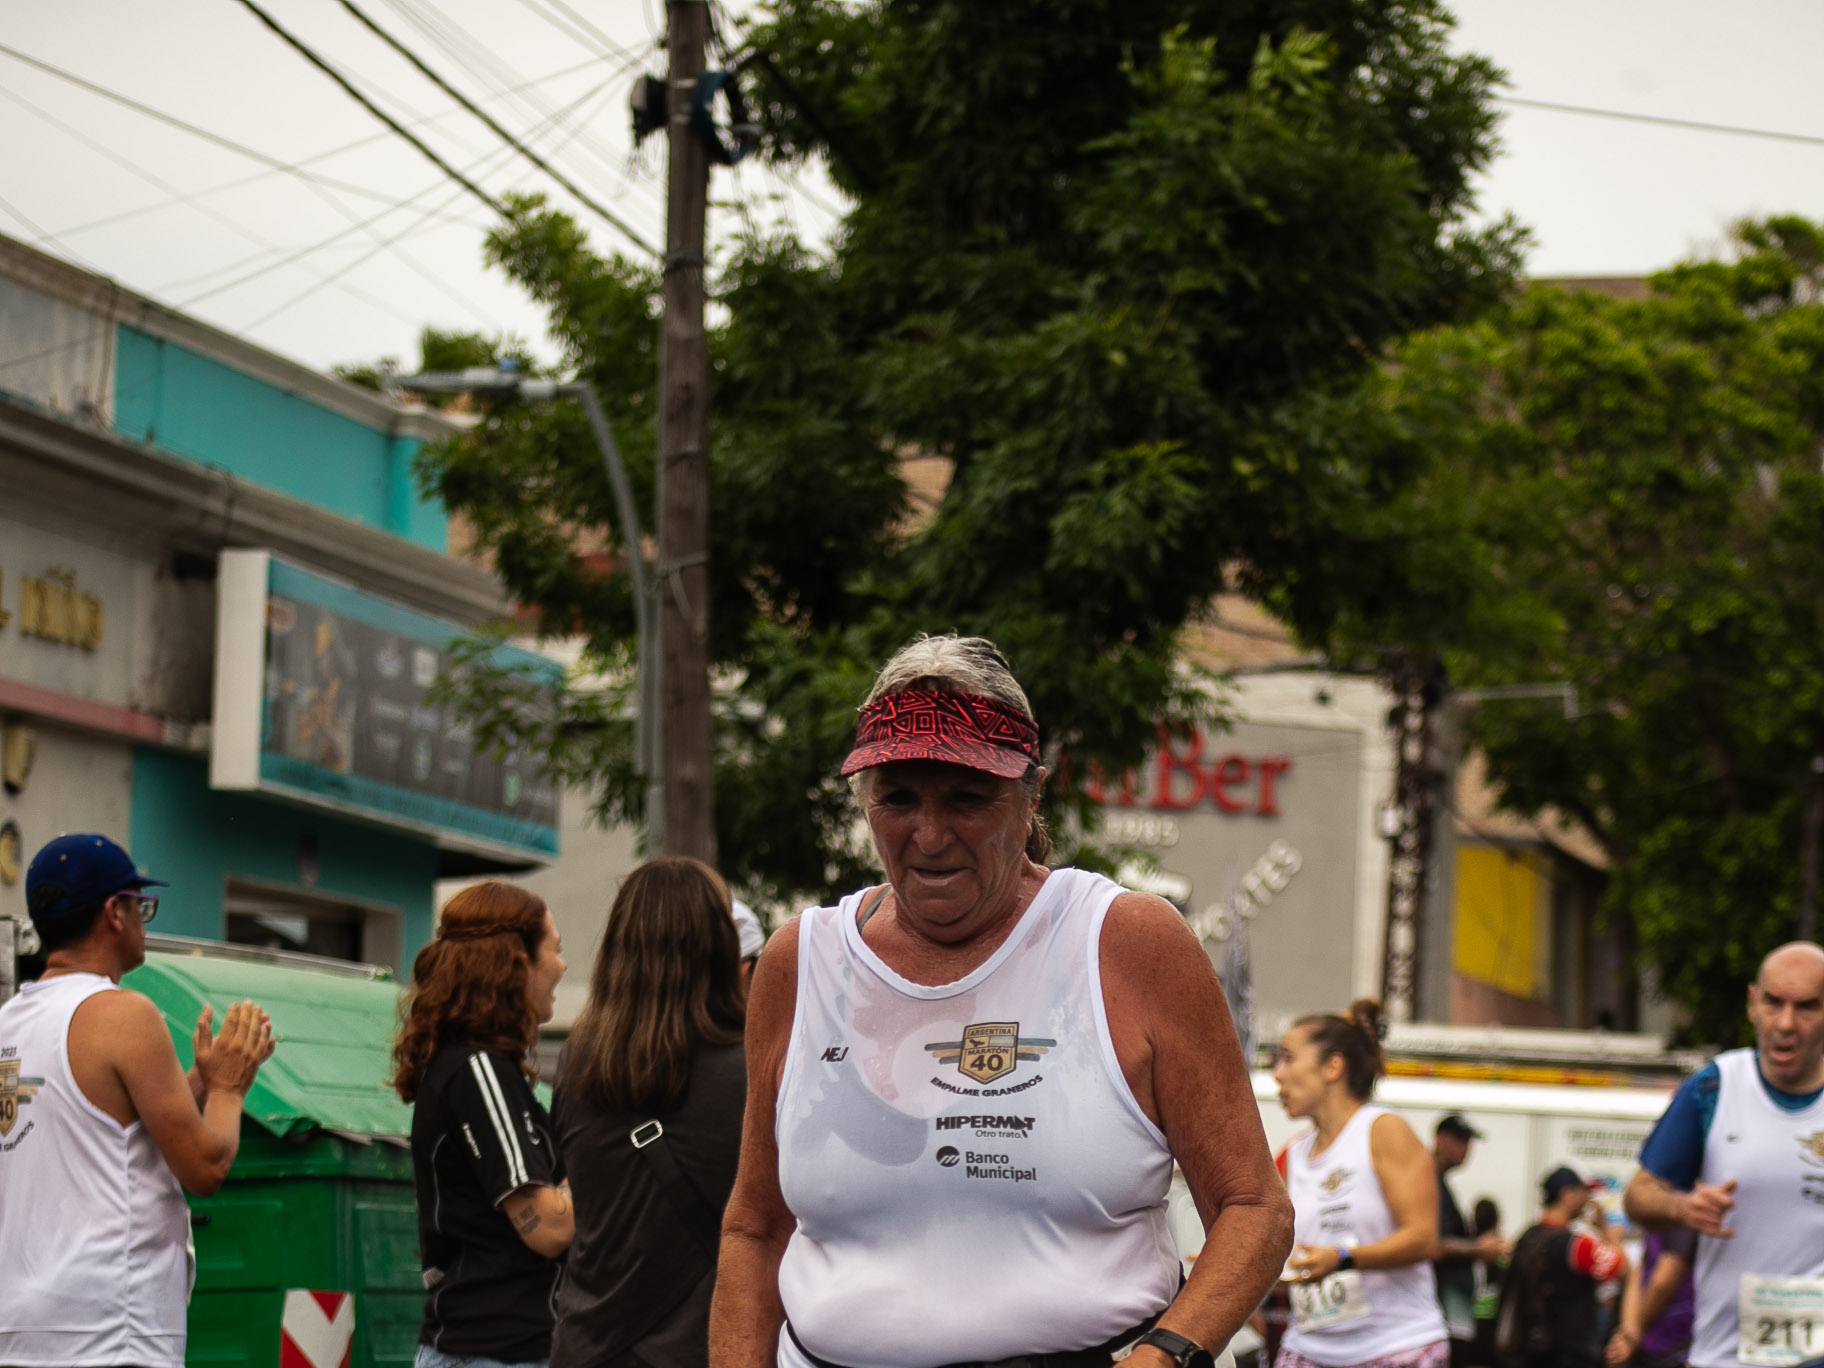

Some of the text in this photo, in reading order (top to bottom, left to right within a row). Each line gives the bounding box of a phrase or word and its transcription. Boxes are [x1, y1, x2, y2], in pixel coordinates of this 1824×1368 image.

[970, 1028, 1012, 1037] ARGENTINA
[967, 1047, 1009, 1056] MARATÓN
[970, 1054, 1004, 1072] 40
[930, 1074, 1044, 1097] EMPALME GRANEROS
[975, 1129, 997, 1138] Otro
[965, 1151, 1010, 1165] Banco
[966, 1165, 1038, 1183] Municipal
[1757, 1316, 1813, 1349] 211
